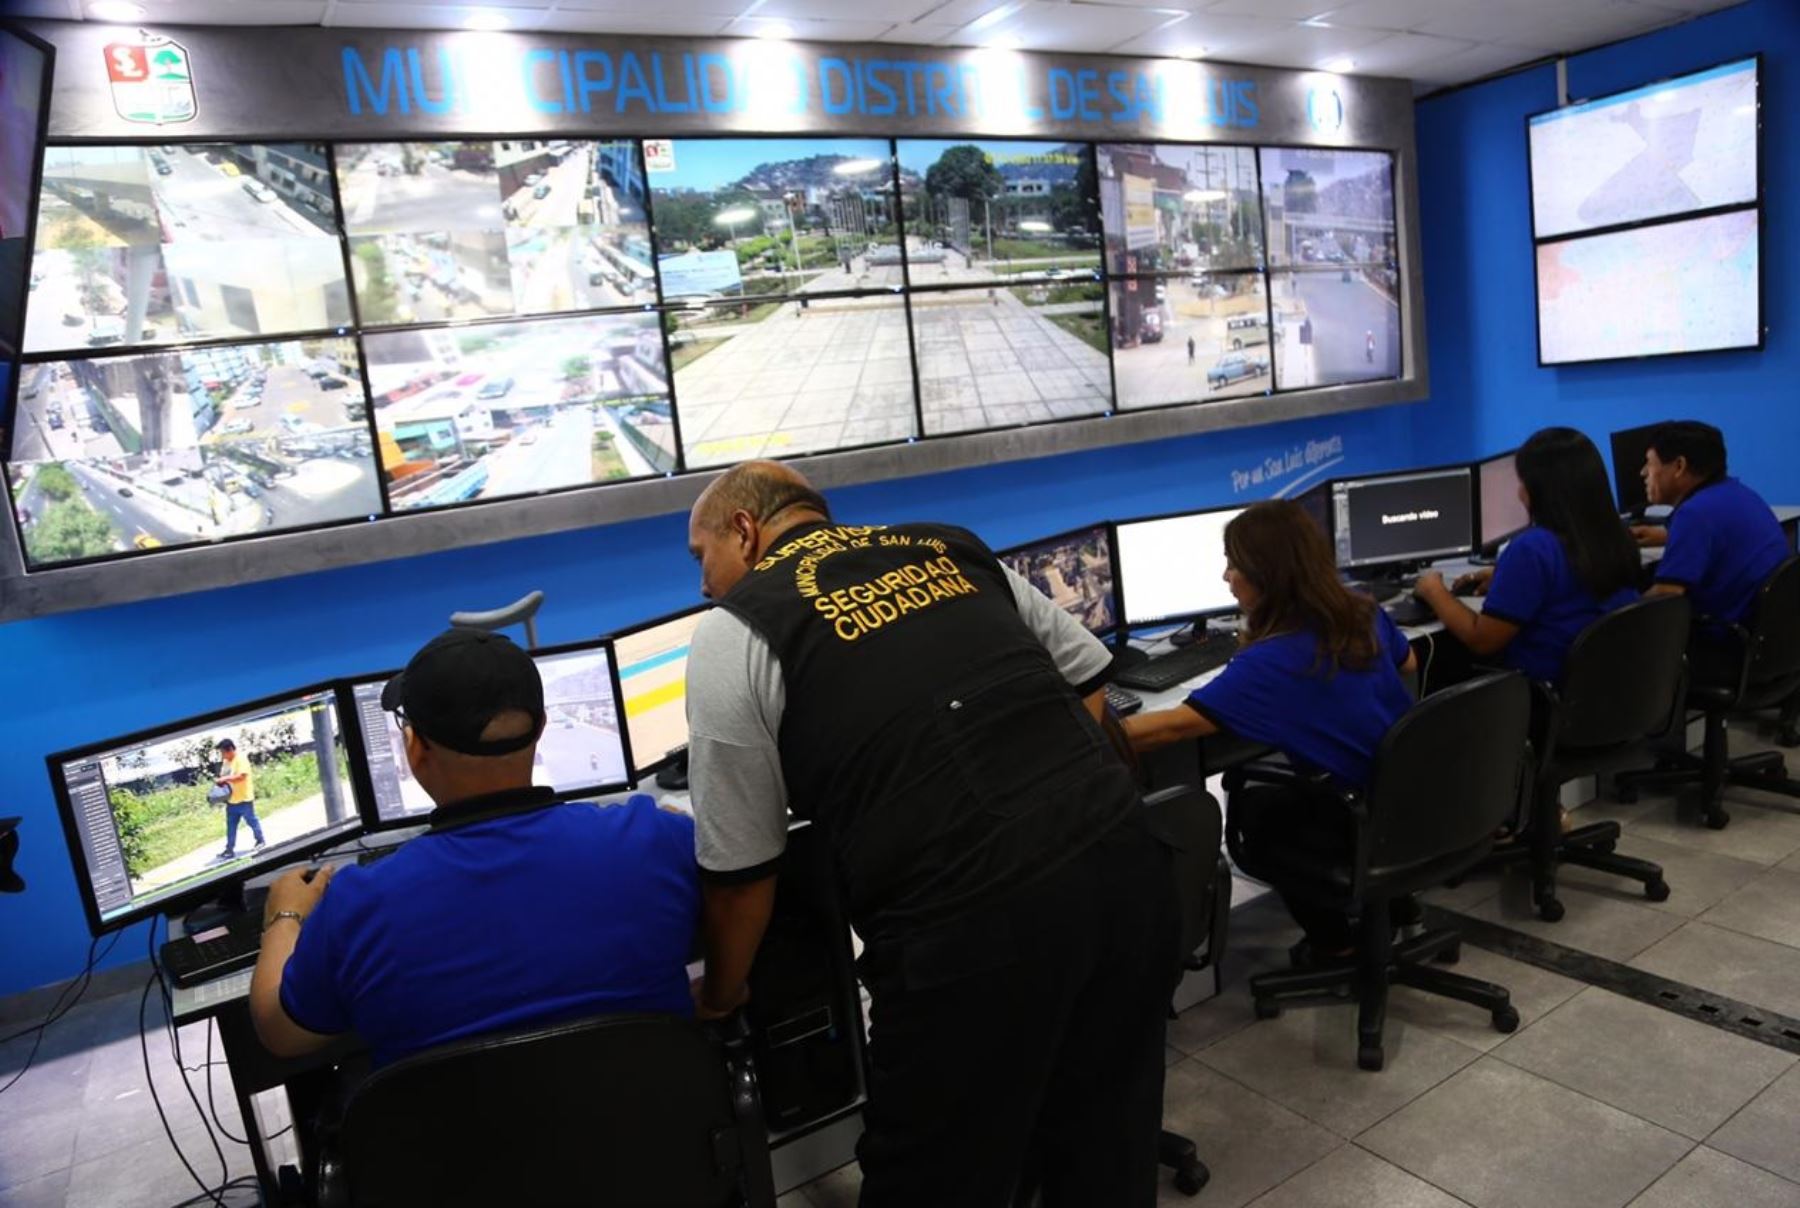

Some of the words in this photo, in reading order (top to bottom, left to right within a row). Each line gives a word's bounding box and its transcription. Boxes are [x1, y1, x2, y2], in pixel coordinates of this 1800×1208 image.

[341, 46, 808, 116] MUCIPALIDD
[818, 57, 1044, 120] DISTRITL
[1048, 67, 1103, 122] DE
[1107, 71, 1166, 124] SA
[850, 537, 873, 548] DE
[879, 535, 912, 547] SAN
[916, 537, 948, 555] LUIS
[814, 556, 960, 620] SEGURIDAD
[834, 575, 980, 641] CIUDADANA
